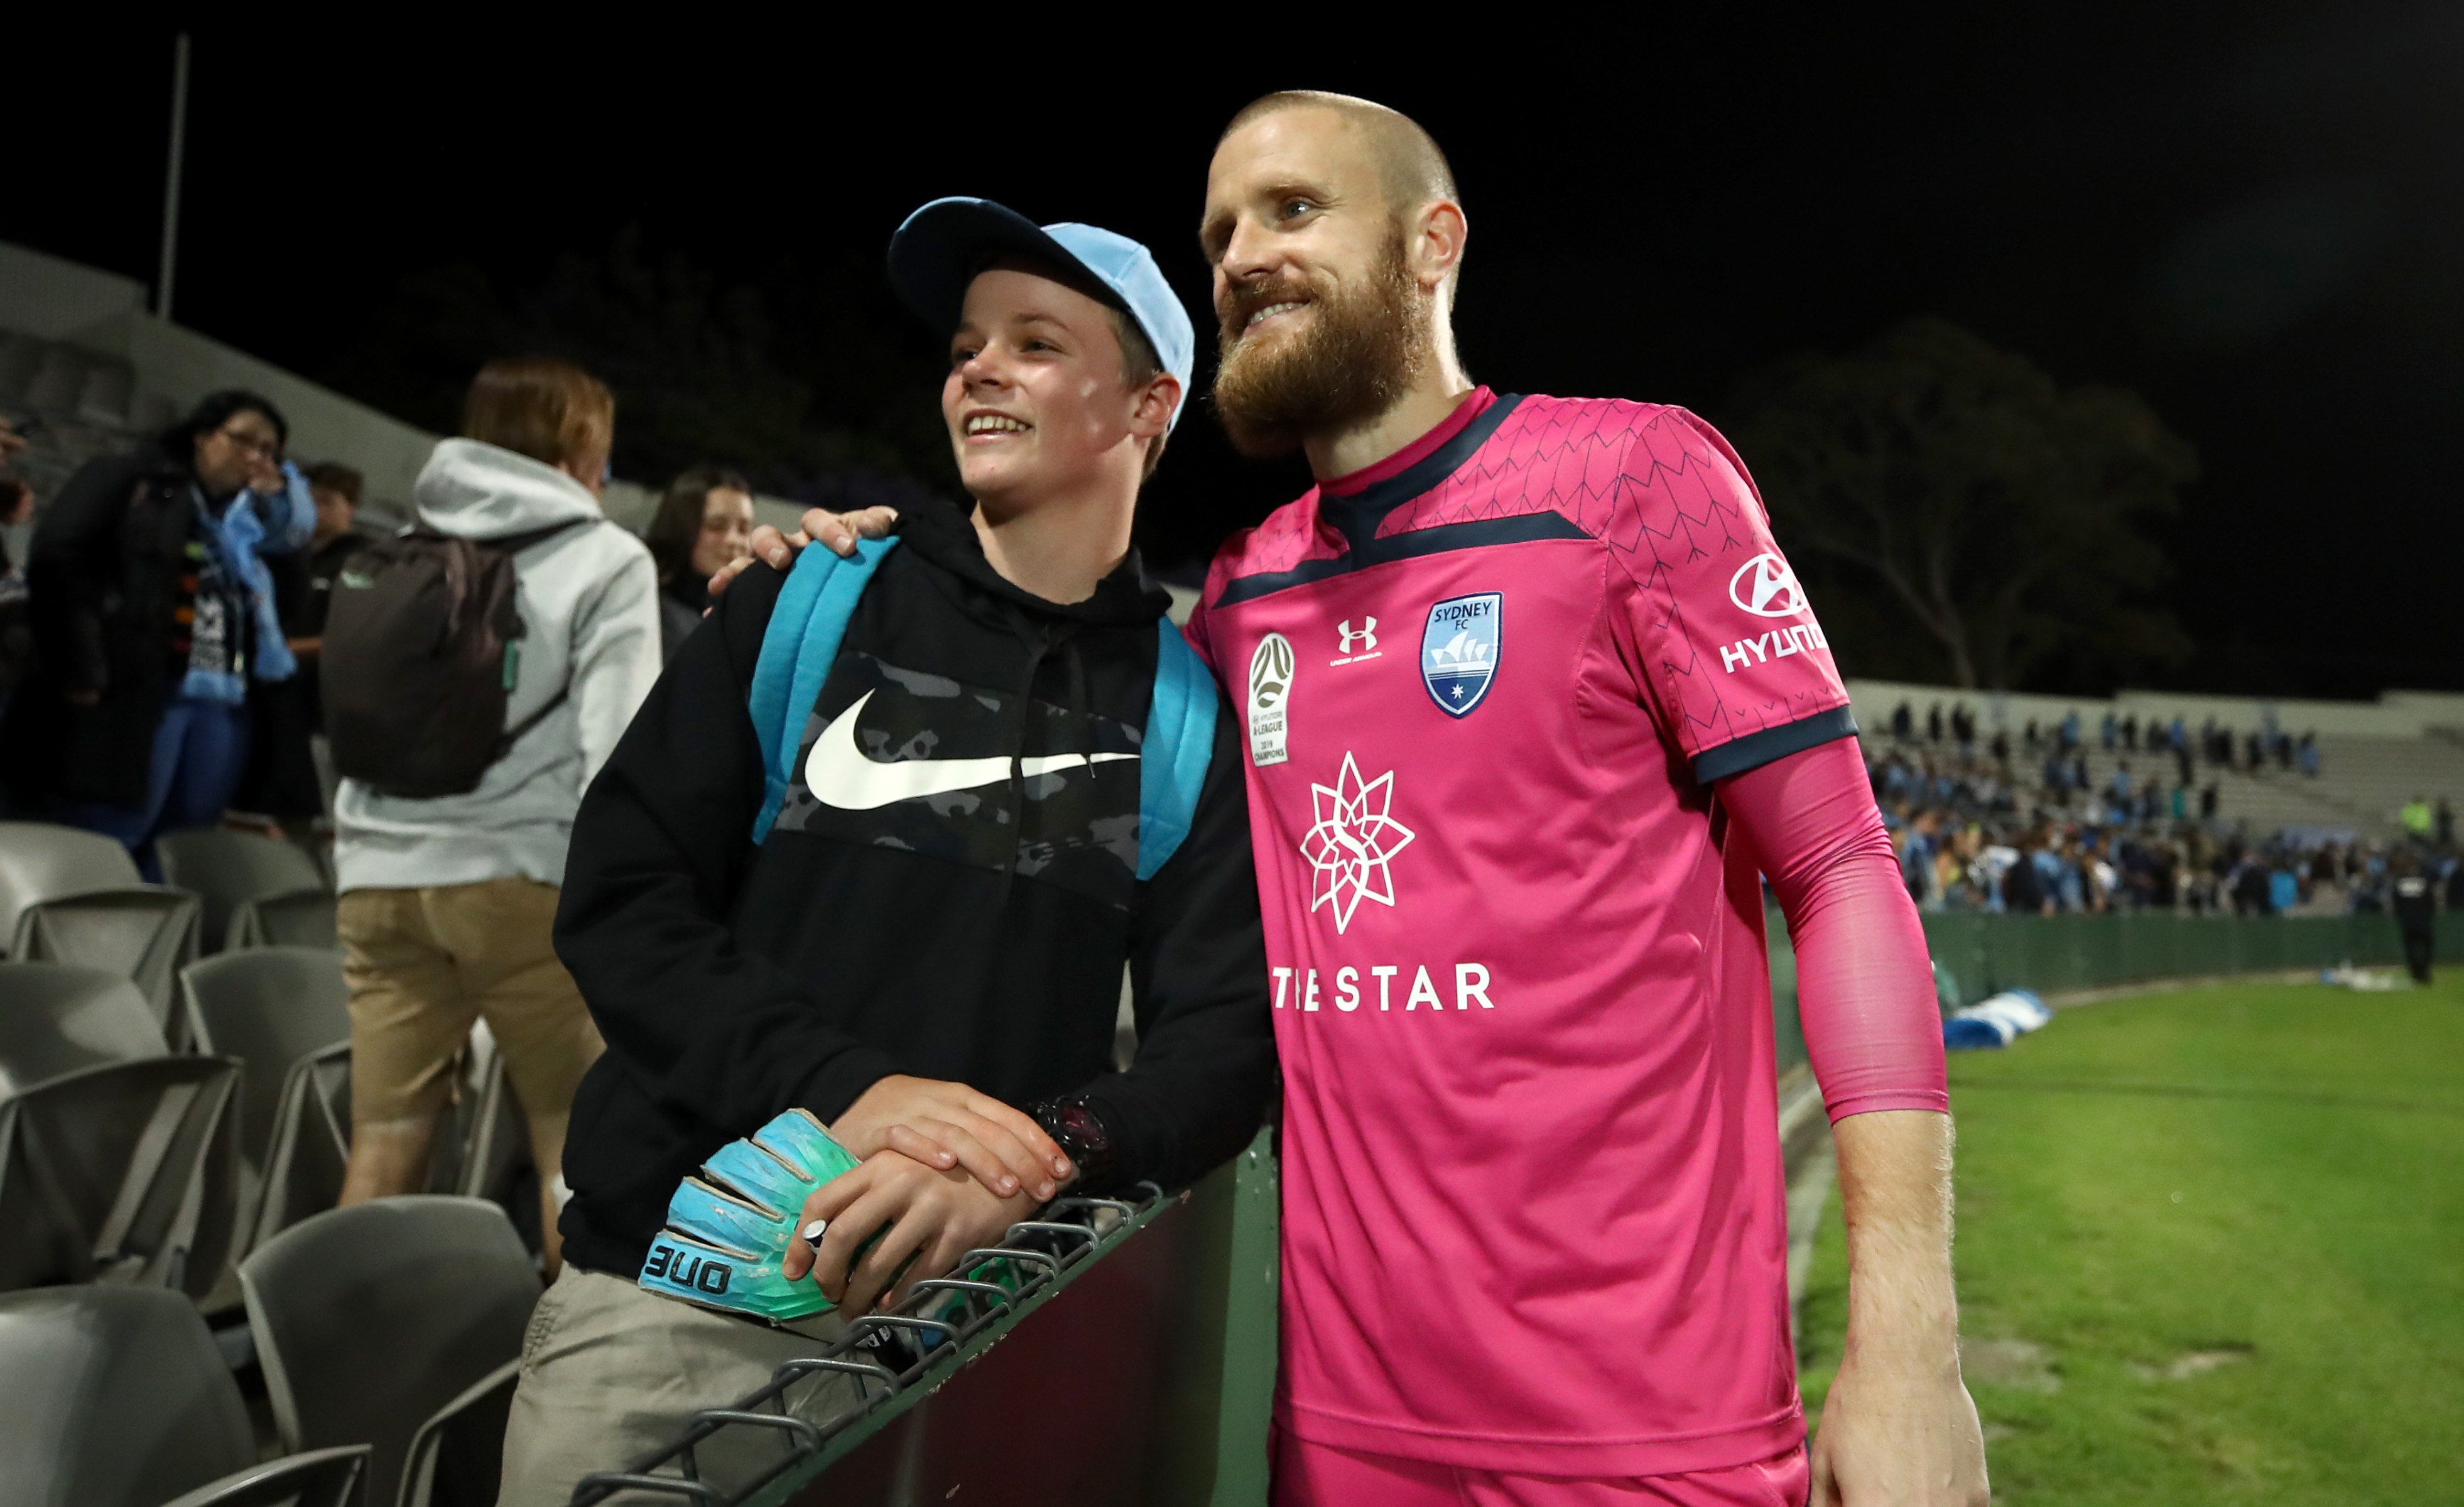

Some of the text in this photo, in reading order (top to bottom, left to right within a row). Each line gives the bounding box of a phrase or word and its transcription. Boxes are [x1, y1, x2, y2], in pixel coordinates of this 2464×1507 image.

[1435, 601, 1492, 623] SYDNEY
[1455, 619, 1468, 631] FC
[1273, 963, 1495, 1012] TE STAR
